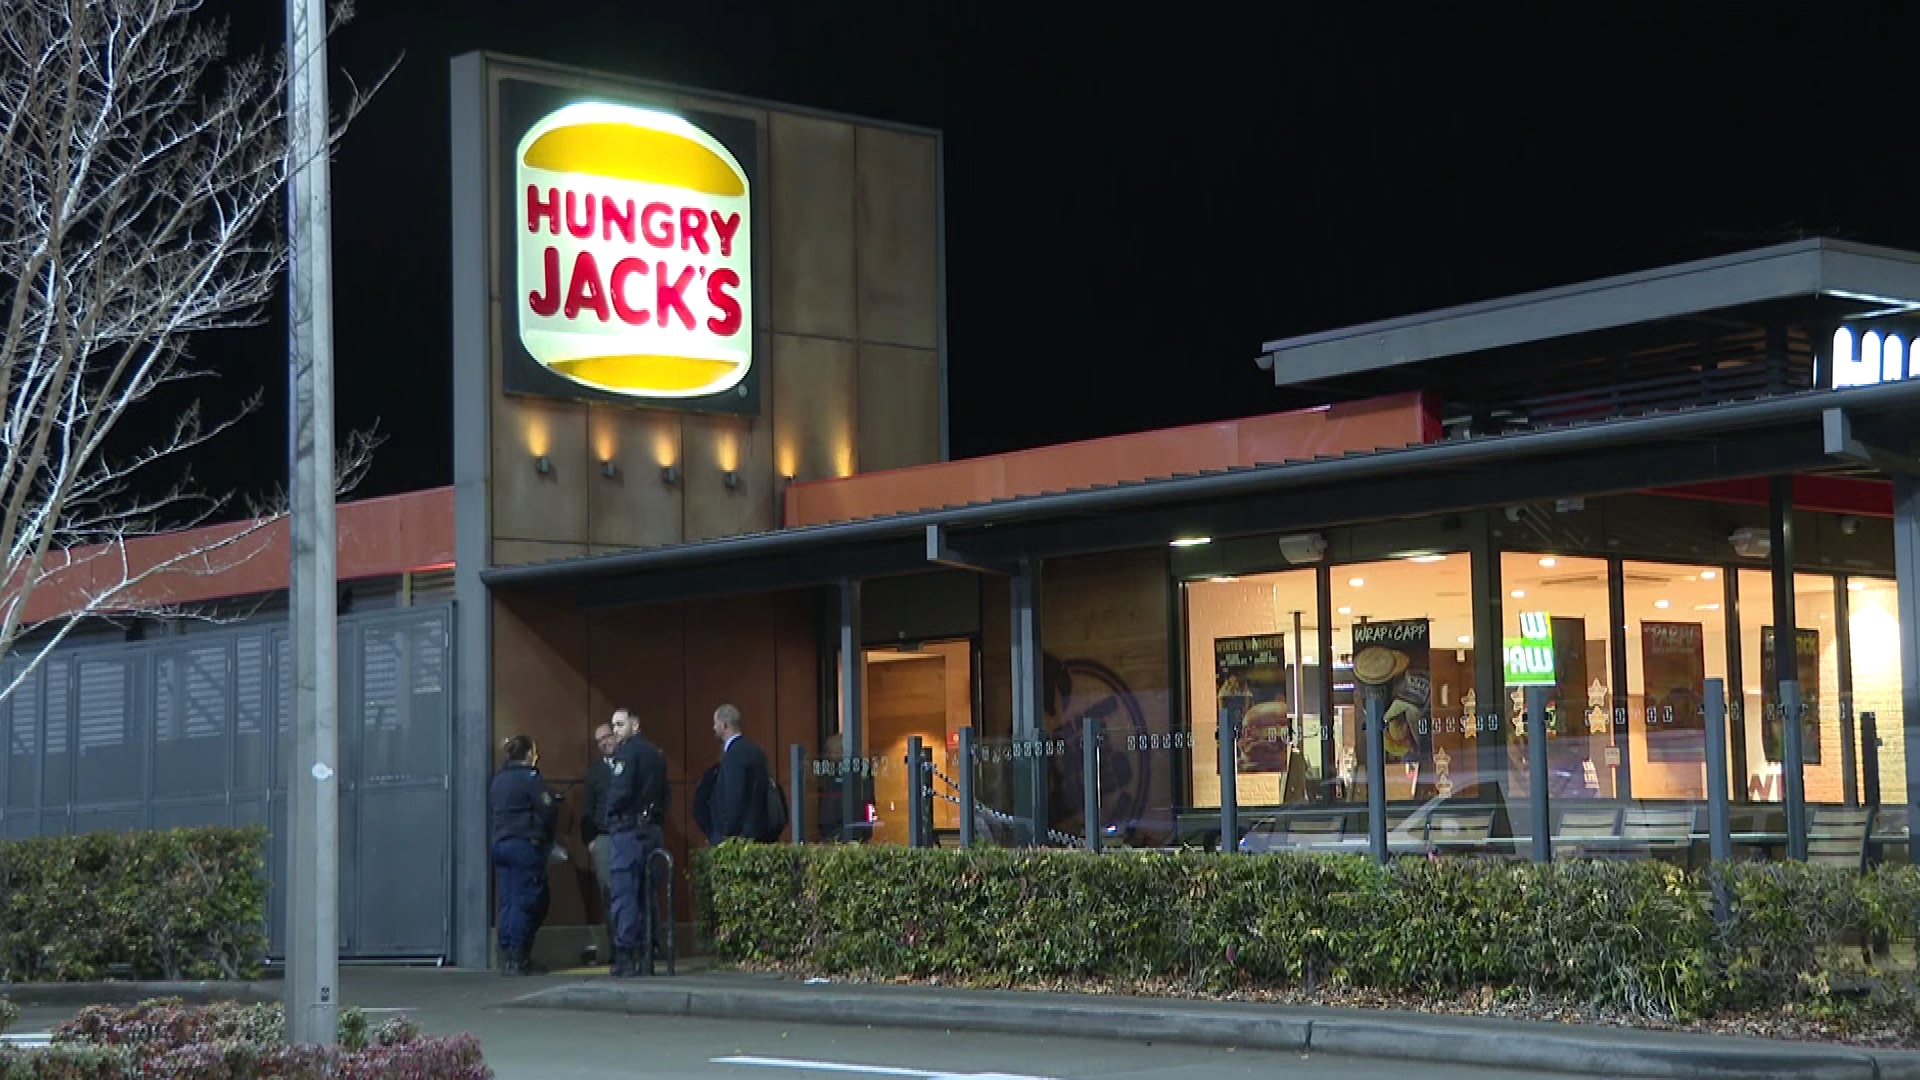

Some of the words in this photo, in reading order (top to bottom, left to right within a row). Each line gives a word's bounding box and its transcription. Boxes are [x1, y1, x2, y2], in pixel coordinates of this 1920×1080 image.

[527, 184, 741, 257] HUNGRY
[529, 246, 743, 337] JACK'S
[1355, 626, 1387, 643] WRAP
